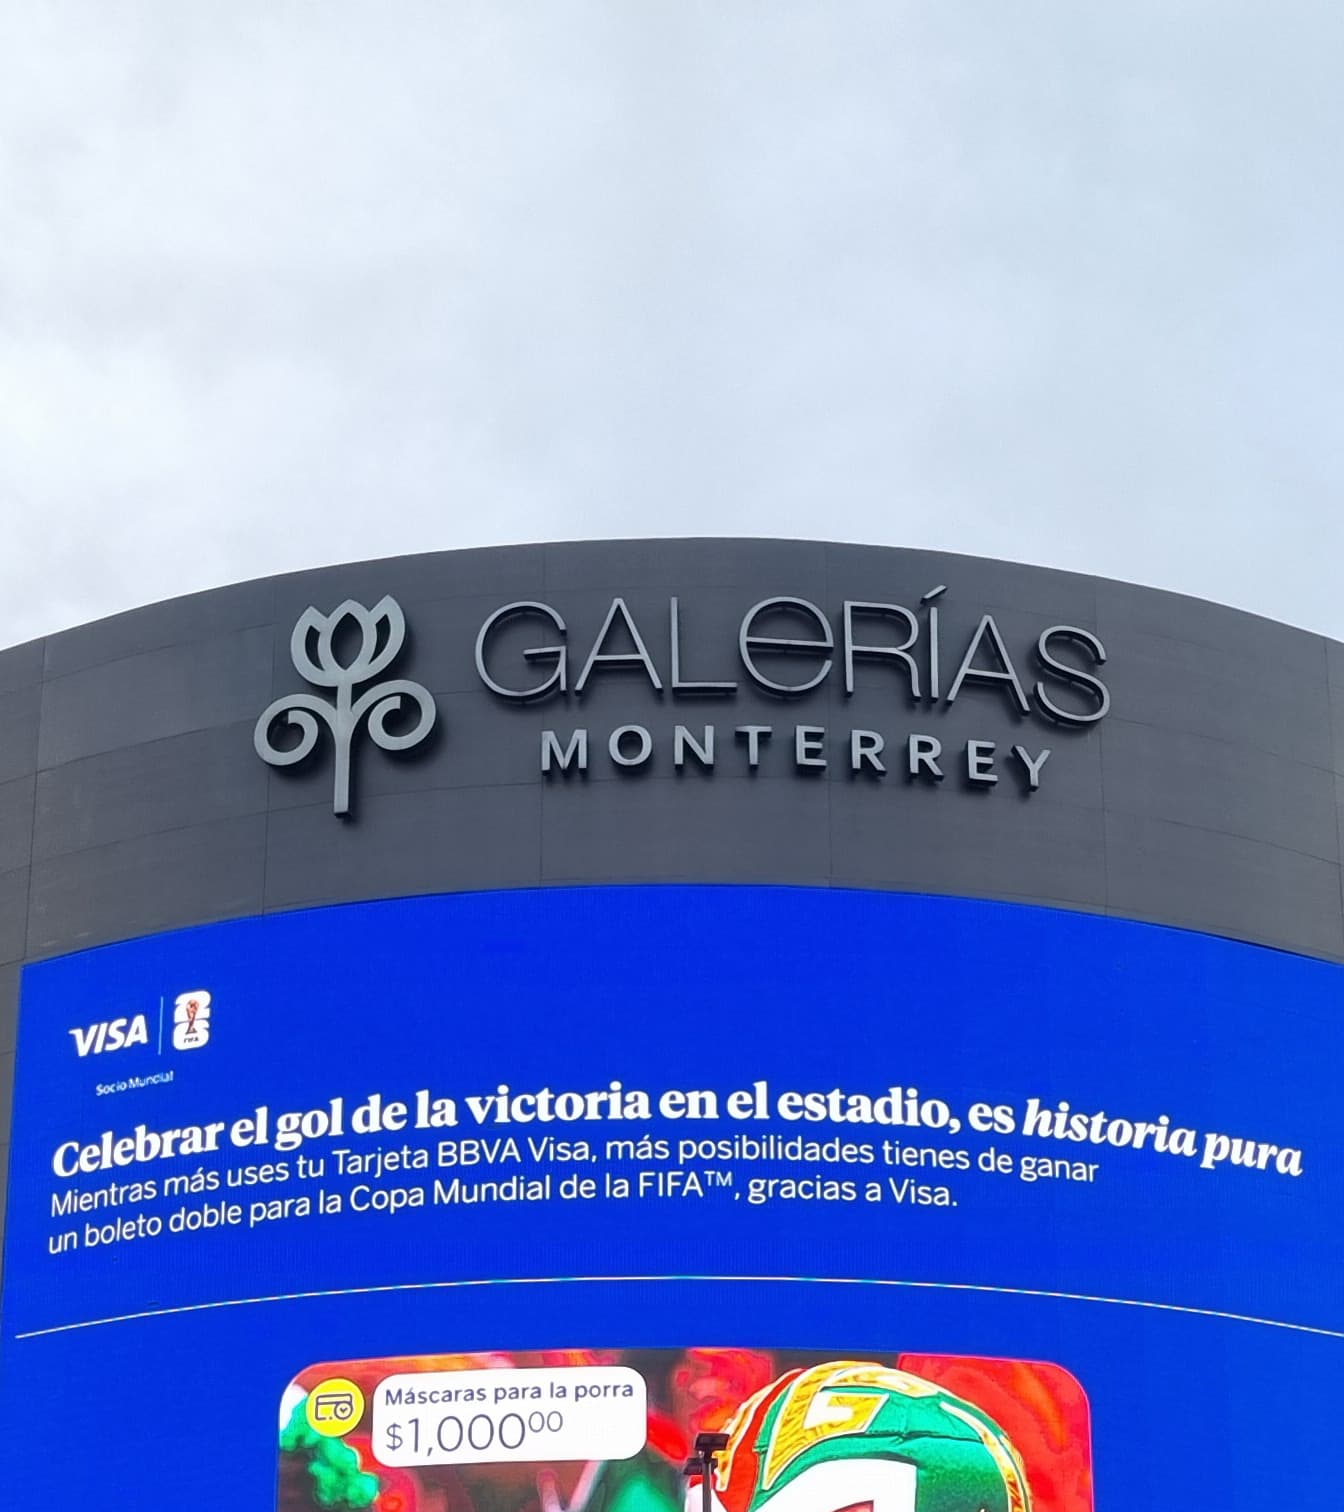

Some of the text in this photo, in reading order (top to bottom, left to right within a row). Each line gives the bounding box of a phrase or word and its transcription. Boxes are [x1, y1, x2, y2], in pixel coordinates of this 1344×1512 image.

[541, 725, 1052, 792] MONTERREY
[69, 1014, 149, 1057] VISA
[96, 1070, 174, 1097] Socio Mundial
[52, 1081, 1303, 1178] Celebrar el gol de la victoria en el estadio, es historia pura
[51, 1134, 1100, 1218] Mientras más uses tu Tarjeta BBVA Visa, más posibilidades tienes de ganar
[48, 1231, 78, 1255] un
[84, 1213, 163, 1248] boleto
[168, 1200, 243, 1233] doble
[249, 1194, 311, 1229] para
[318, 1189, 342, 1215] la
[349, 1185, 425, 1216] Copa
[433, 1174, 551, 1206] Mundial
[559, 1173, 597, 1200] de
[605, 1172, 630, 1199] la
[747, 1176, 857, 1205] gracias
[865, 1182, 882, 1202] a
[888, 1177, 960, 1208] Visa.
[384, 1381, 634, 1407] Máscaras para la porra
